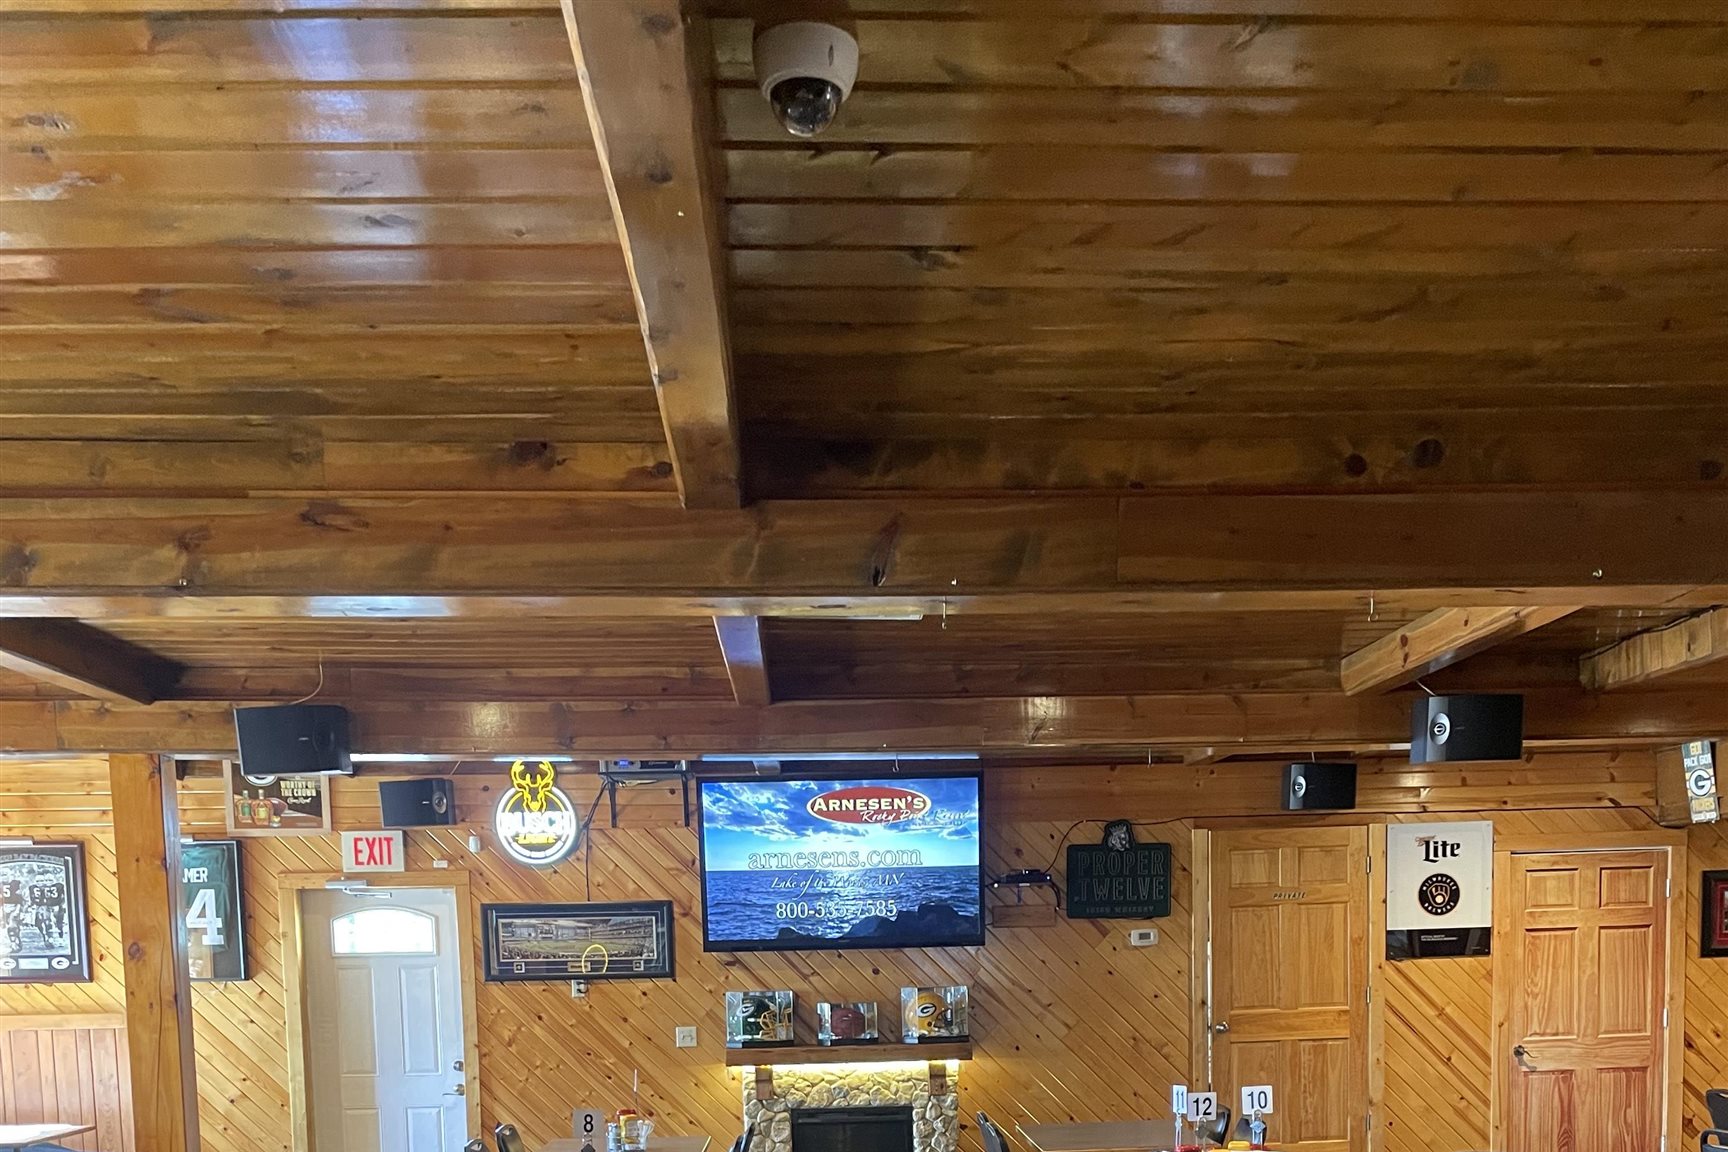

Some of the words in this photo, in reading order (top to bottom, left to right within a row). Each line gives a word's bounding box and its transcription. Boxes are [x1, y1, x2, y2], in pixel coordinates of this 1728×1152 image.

[813, 795, 926, 812] ARNESEN'S
[500, 811, 572, 835] BUSCH
[860, 810, 896, 826] Rocky
[353, 836, 394, 866] EXIT
[747, 848, 923, 870] arnesens.com
[1422, 840, 1461, 864] Lite
[1078, 850, 1164, 876] PROPER
[182, 867, 208, 883] MER
[771, 873, 797, 889] Lake
[1079, 877, 1165, 901] TWELVE
[185, 888, 225, 946] 4
[775, 900, 898, 920] 800-535-7585
[1175, 1090, 1185, 1109] 11
[1193, 1097, 1212, 1117] 12
[1247, 1090, 1268, 1109] 10
[583, 1113, 594, 1133] 8
